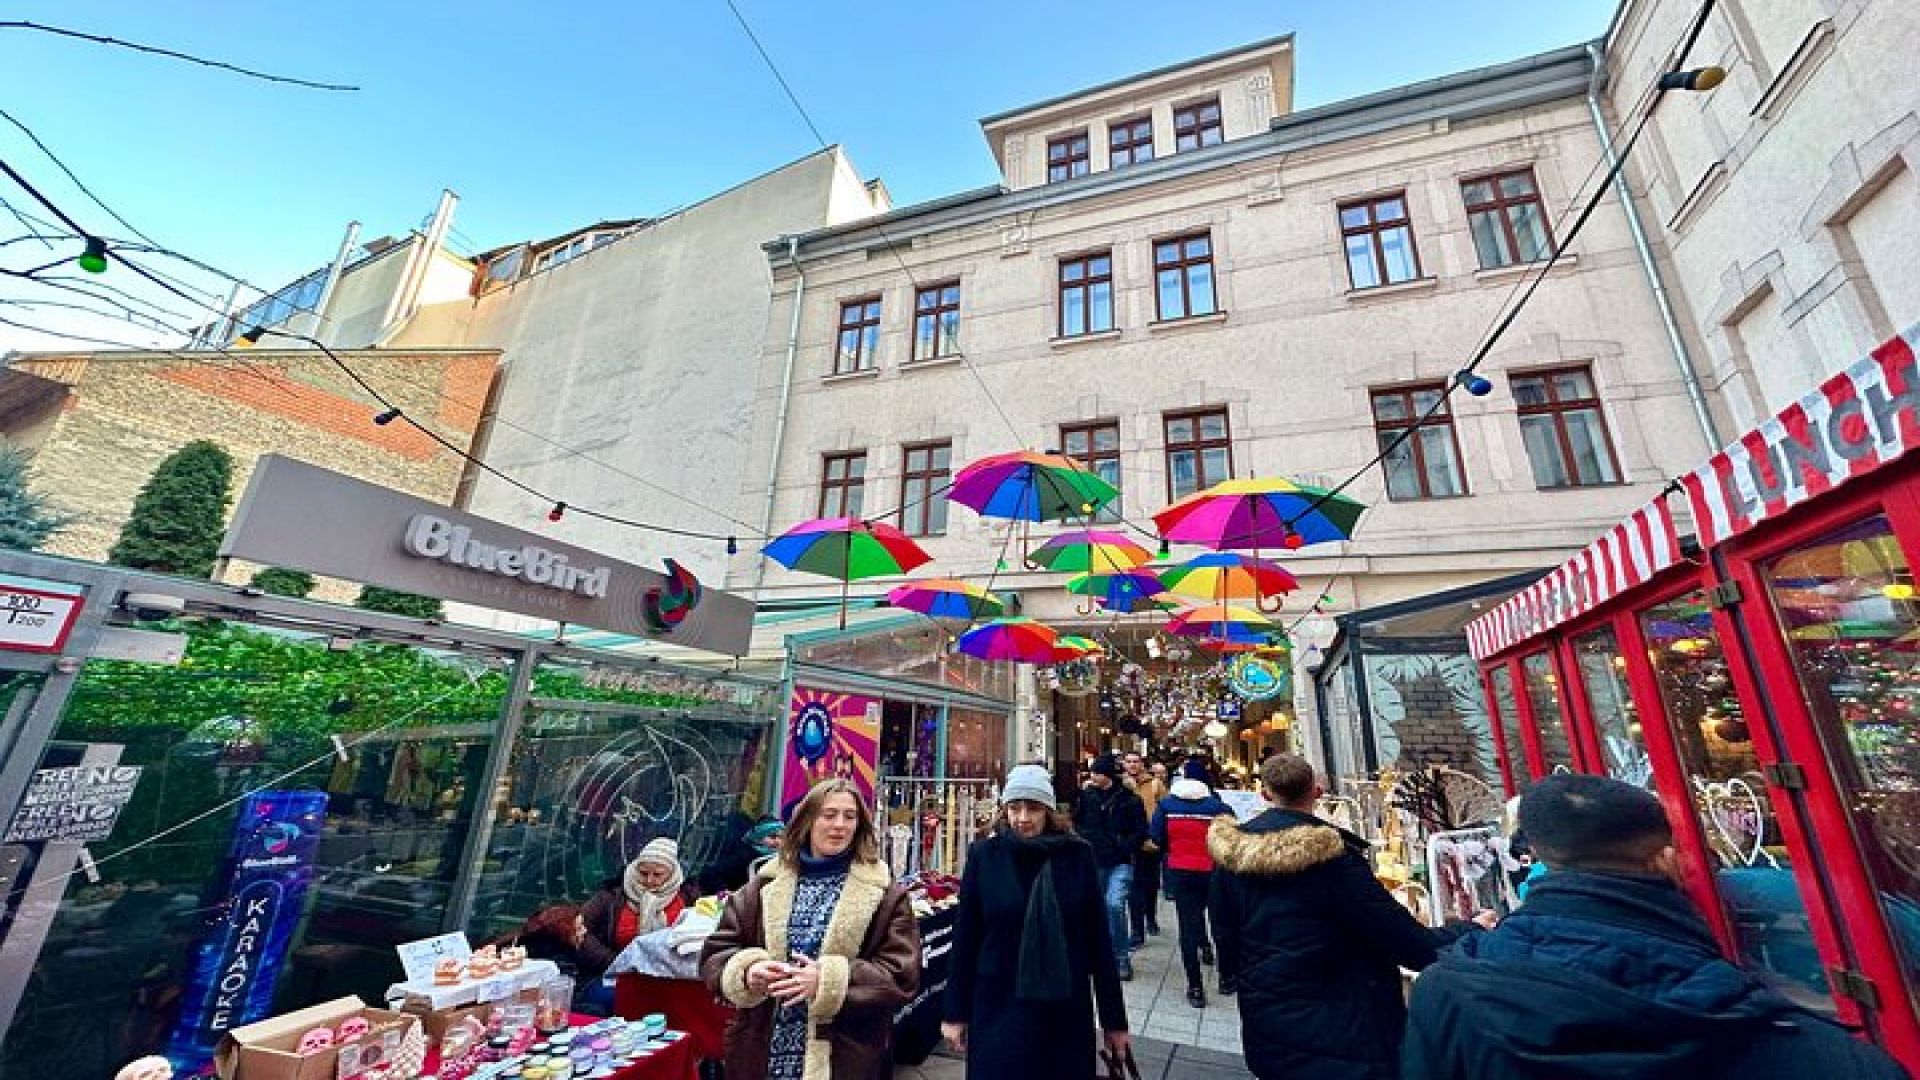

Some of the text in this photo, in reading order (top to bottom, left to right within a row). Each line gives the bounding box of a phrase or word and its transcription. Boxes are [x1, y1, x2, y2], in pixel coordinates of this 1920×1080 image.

[1727, 361, 1920, 518] LUNCH
[405, 514, 612, 598] BlueBird
[210, 897, 269, 1030] KARAOKE
